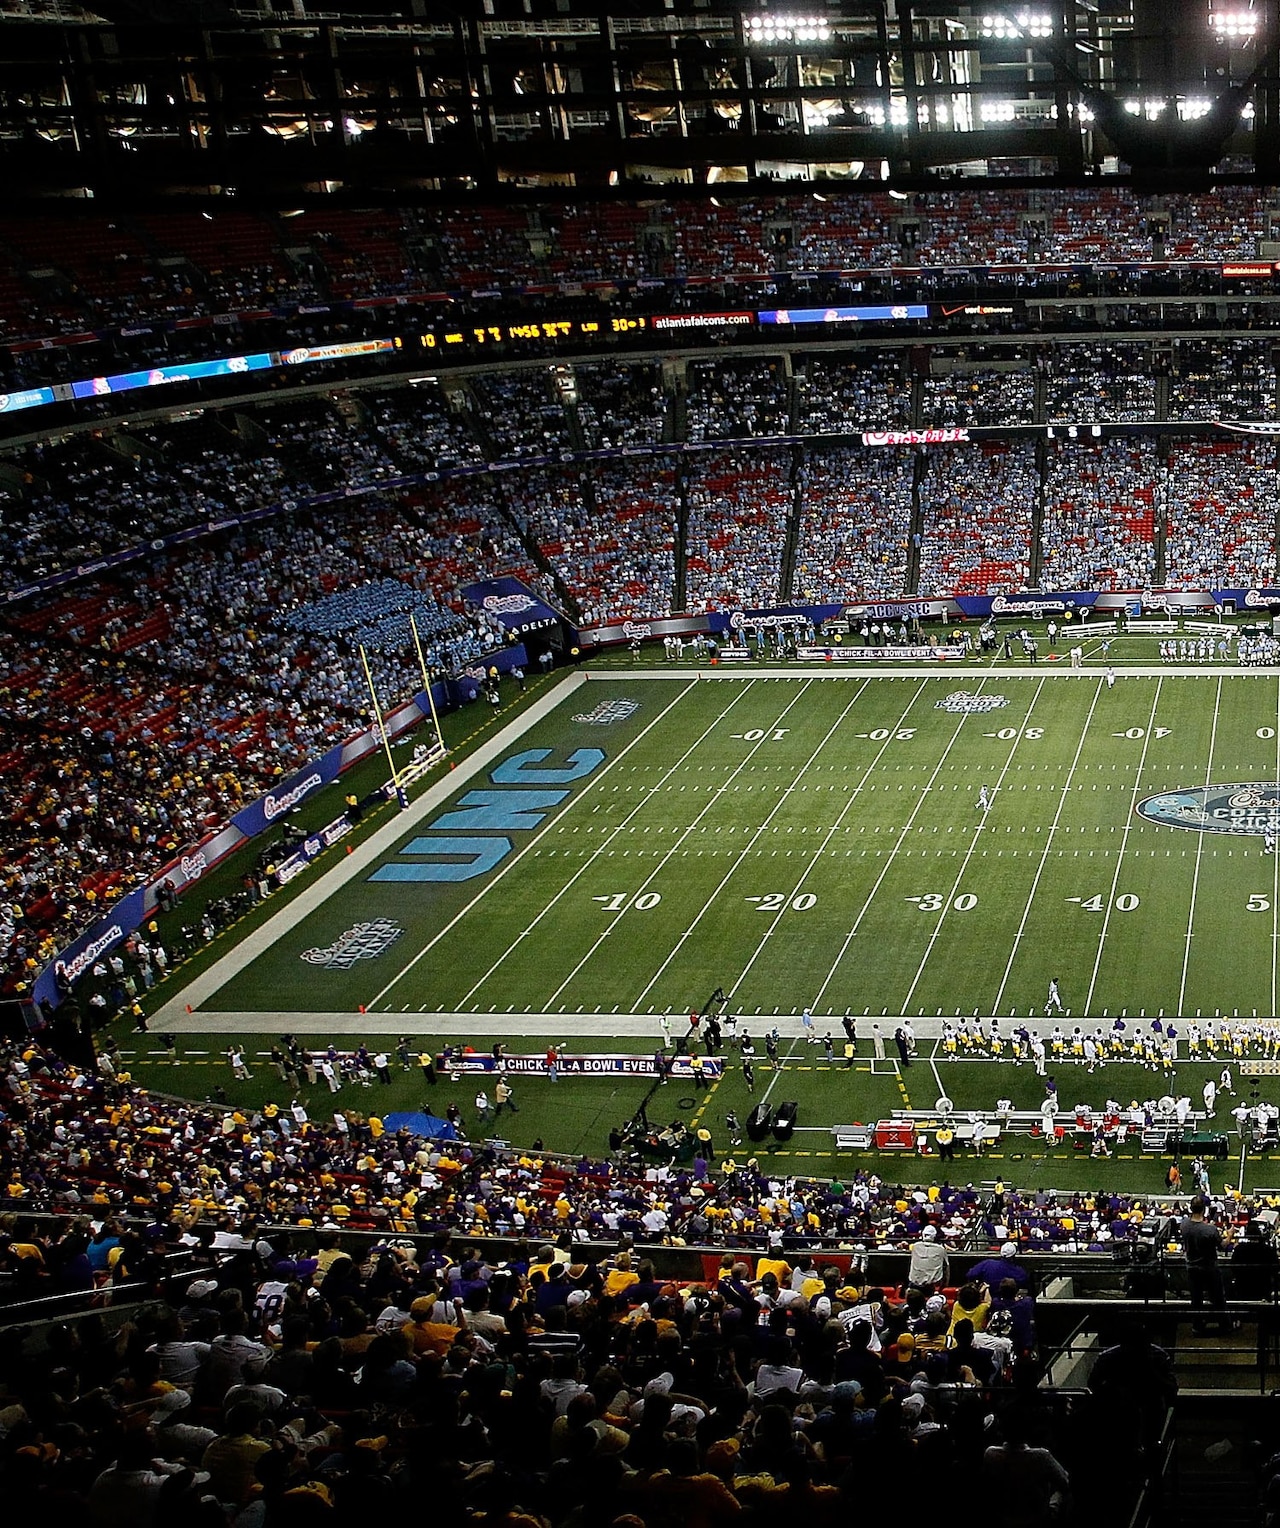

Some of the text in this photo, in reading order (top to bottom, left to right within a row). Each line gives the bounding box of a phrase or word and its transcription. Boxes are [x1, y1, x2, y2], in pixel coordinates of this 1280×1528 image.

[656, 315, 750, 329] atlantafalcons.com
[909, 603, 930, 615] SEC
[521, 617, 558, 632] DELTA
[742, 728, 791, 741] 10
[868, 728, 916, 741] 20
[997, 727, 1045, 740] 30
[1126, 727, 1173, 740] 40
[367, 747, 607, 883] UNC
[600, 891, 661, 911] 10
[755, 892, 818, 911] 20
[918, 892, 978, 912] 30
[1081, 892, 1140, 912] 40
[507, 1059, 656, 1072] CHICK-IL-A BOWL EVEN
